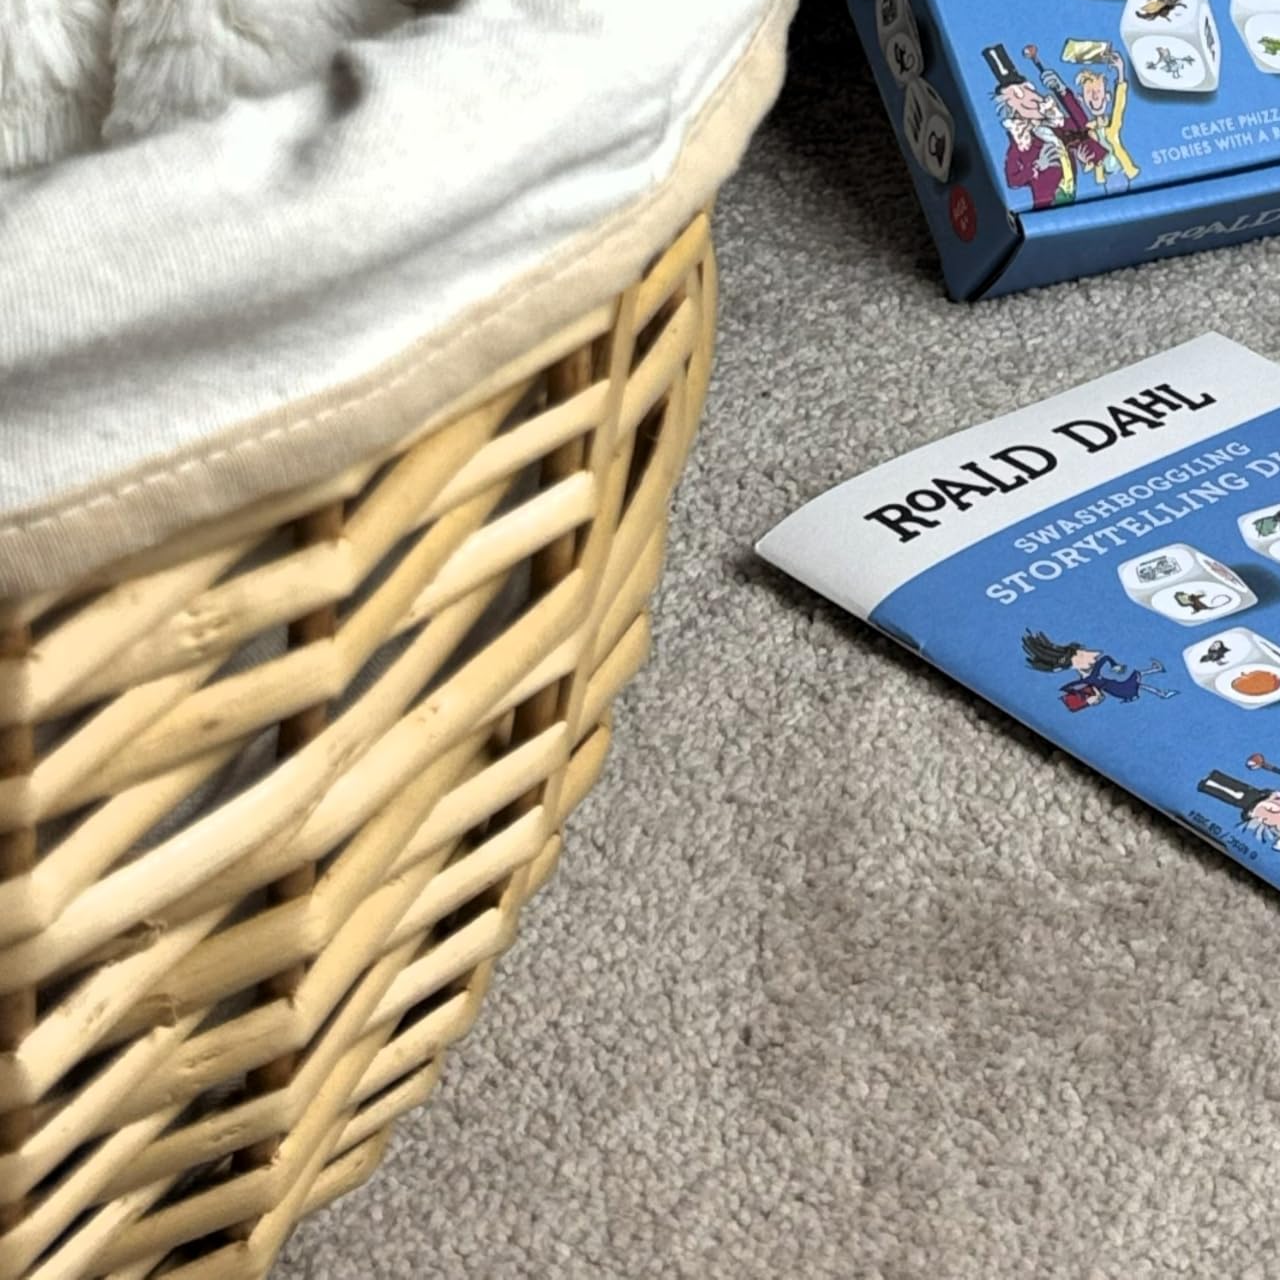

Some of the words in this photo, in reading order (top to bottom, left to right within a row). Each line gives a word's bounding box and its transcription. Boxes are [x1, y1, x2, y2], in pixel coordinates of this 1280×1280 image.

[1151, 140, 1213, 166] STORIES
[1215, 130, 1254, 152] WITH
[1257, 129, 1271, 143] A
[1180, 113, 1236, 141] CREATE
[863, 443, 1060, 544] ROALD
[1052, 382, 1218, 455] DAHL
[1012, 440, 1254, 556] SWASHBOGGLING
[984, 470, 1250, 607] STORYTELLING
